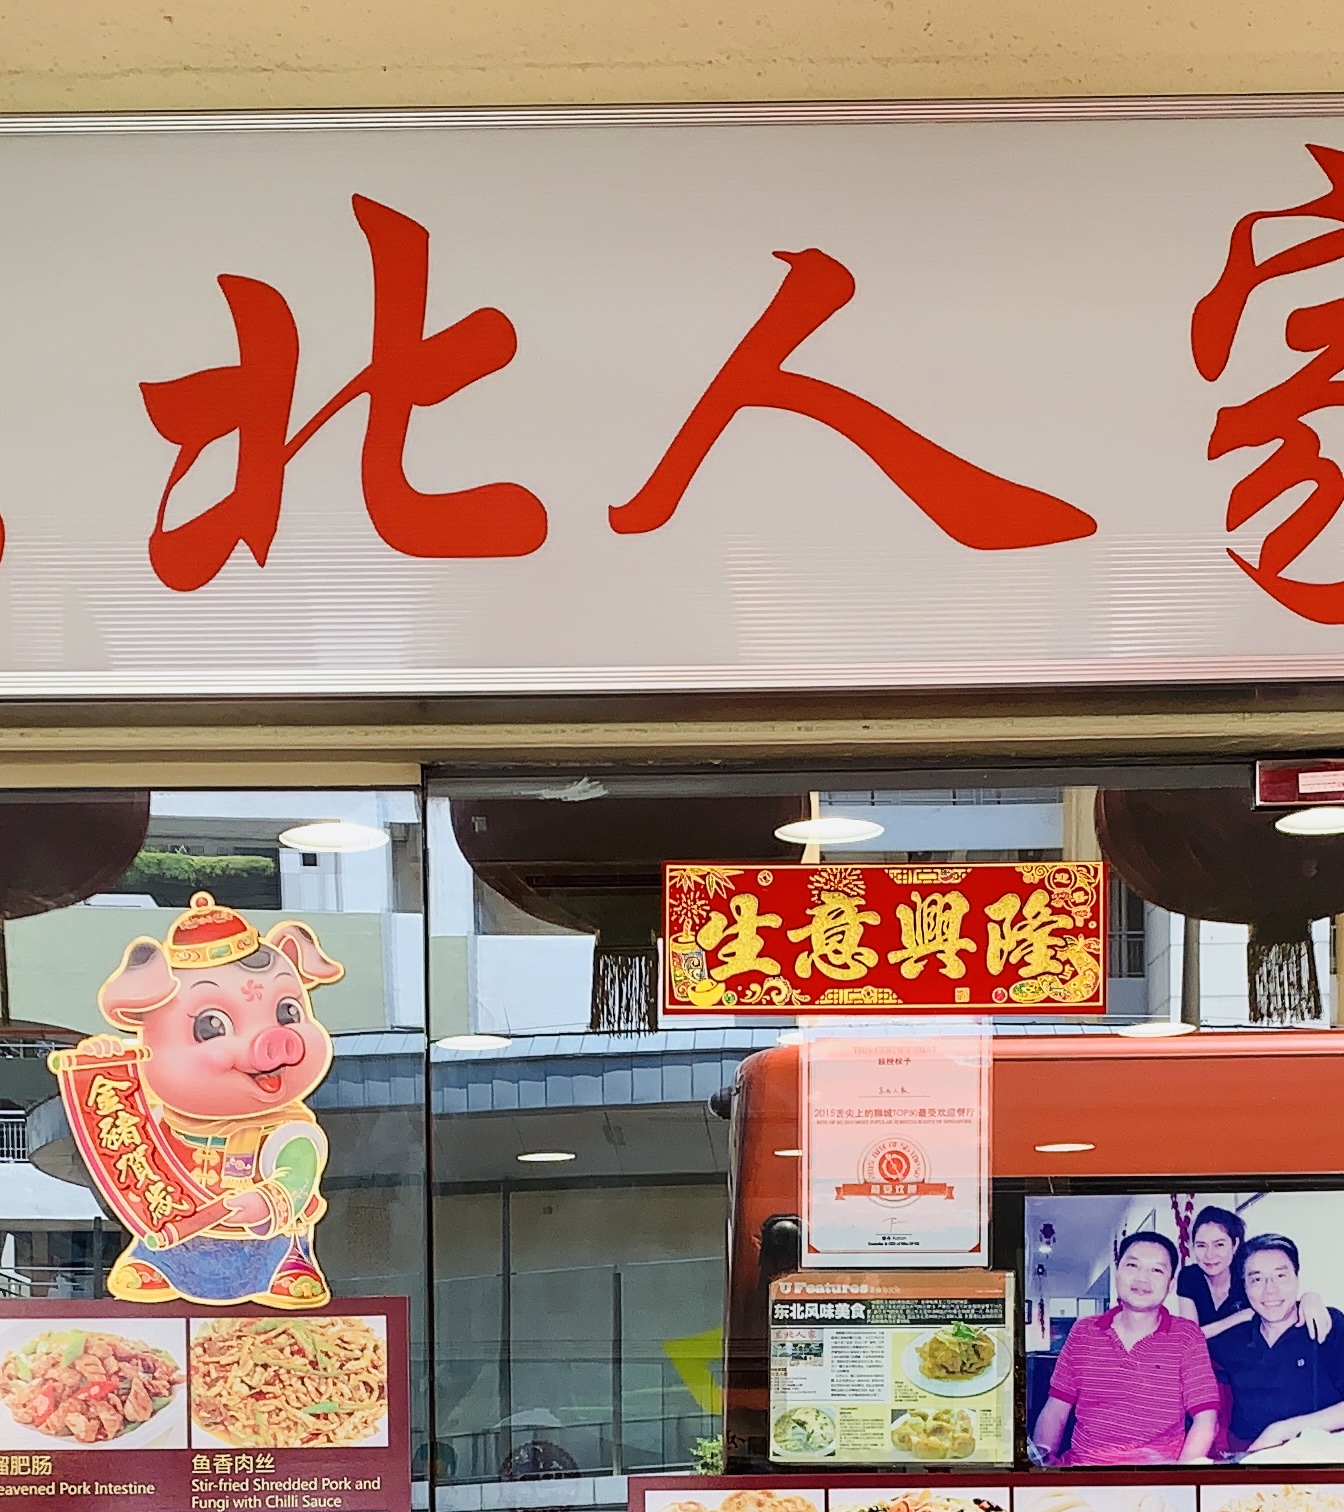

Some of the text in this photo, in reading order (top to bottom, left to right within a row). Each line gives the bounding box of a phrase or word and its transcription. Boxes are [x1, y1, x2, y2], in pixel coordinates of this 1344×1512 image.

[696, 889, 1074, 981] 生意興隆
[794, 1281, 869, 1295] Features
[773, 1302, 867, 1321] 东北风味美食
[192, 1453, 275, 1474] 鱼香肉丝
[60, 1481, 91, 1495] Pork
[94, 1481, 155, 1495] Intestine
